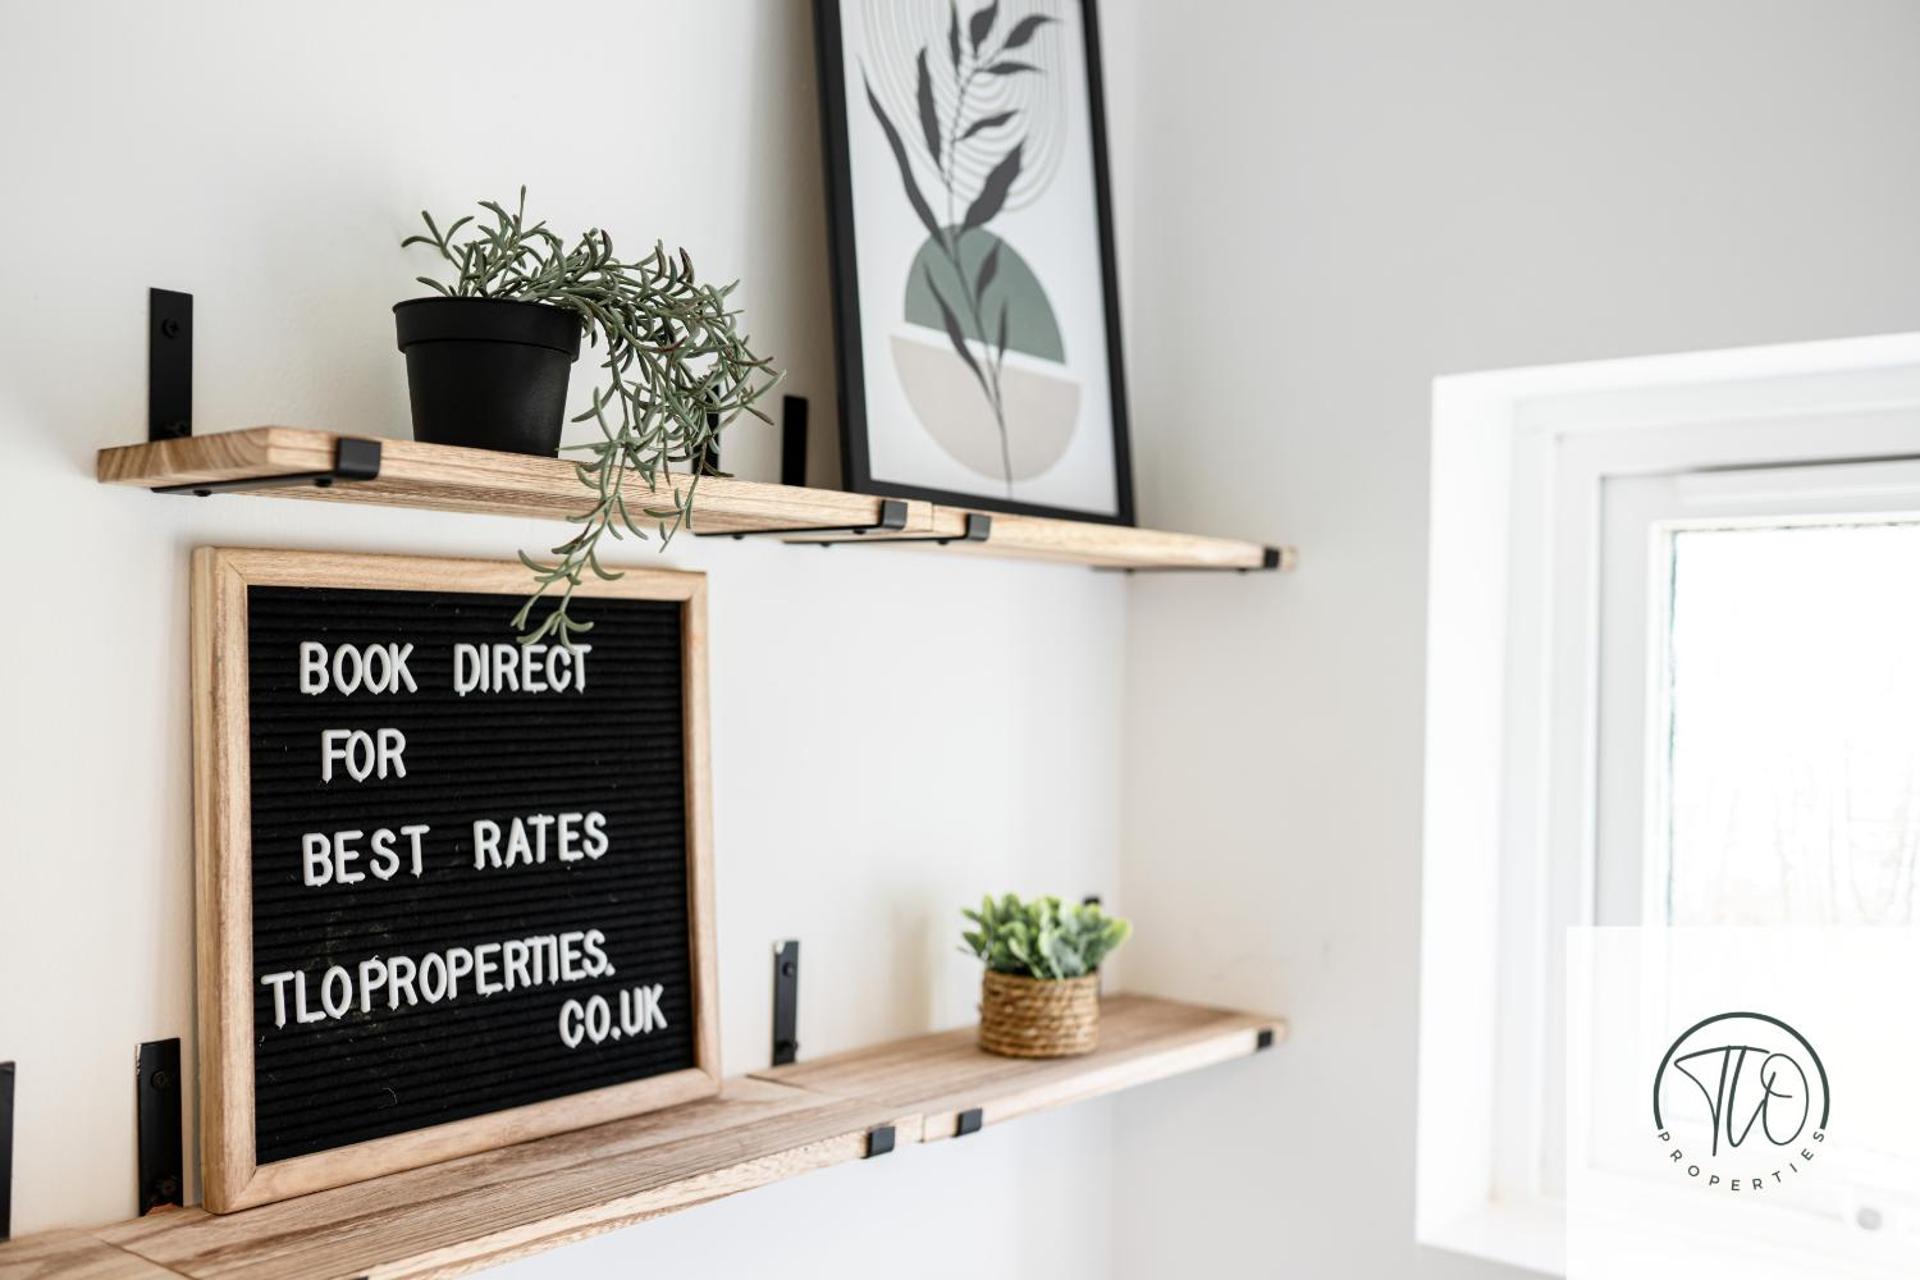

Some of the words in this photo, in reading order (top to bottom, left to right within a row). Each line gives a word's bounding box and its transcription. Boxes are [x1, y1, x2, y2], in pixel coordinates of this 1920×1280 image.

[299, 641, 418, 696] BOOK
[453, 642, 592, 696] DIRECT
[321, 728, 407, 783] FOR
[302, 824, 430, 887] BEST
[472, 812, 609, 870] RATES
[558, 984, 668, 1048] CO.UK
